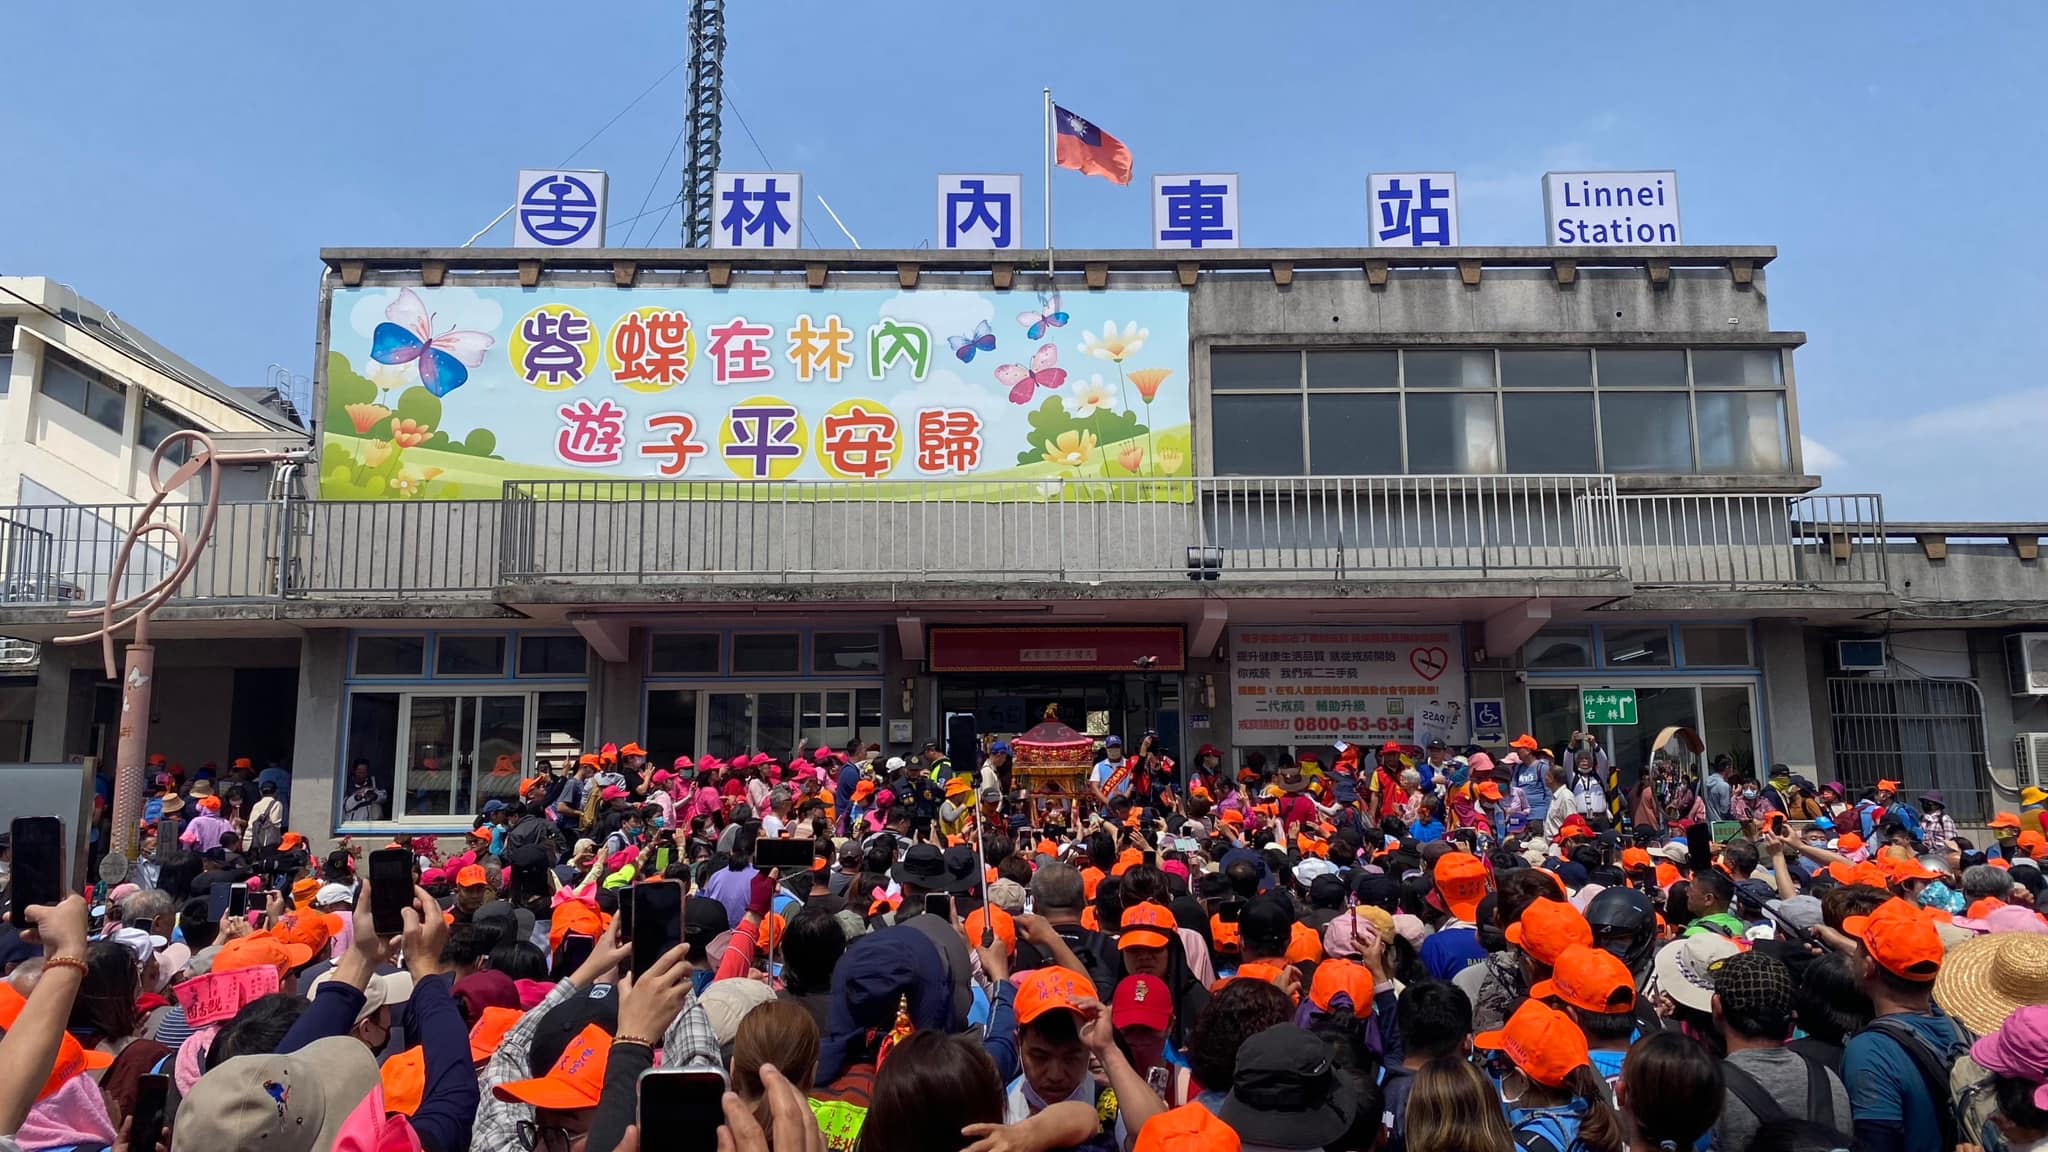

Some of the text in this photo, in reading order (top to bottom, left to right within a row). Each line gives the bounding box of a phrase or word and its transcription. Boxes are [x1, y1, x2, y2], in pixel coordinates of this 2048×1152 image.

[1563, 180, 1665, 208] Linnei
[1557, 217, 1677, 245] Station
[523, 312, 929, 384] 紫蝶在林內
[557, 400, 984, 477] 遊子平安歸
[1584, 695, 1617, 705] 停車場
[1294, 716, 1414, 732] 0800-63-63-6
